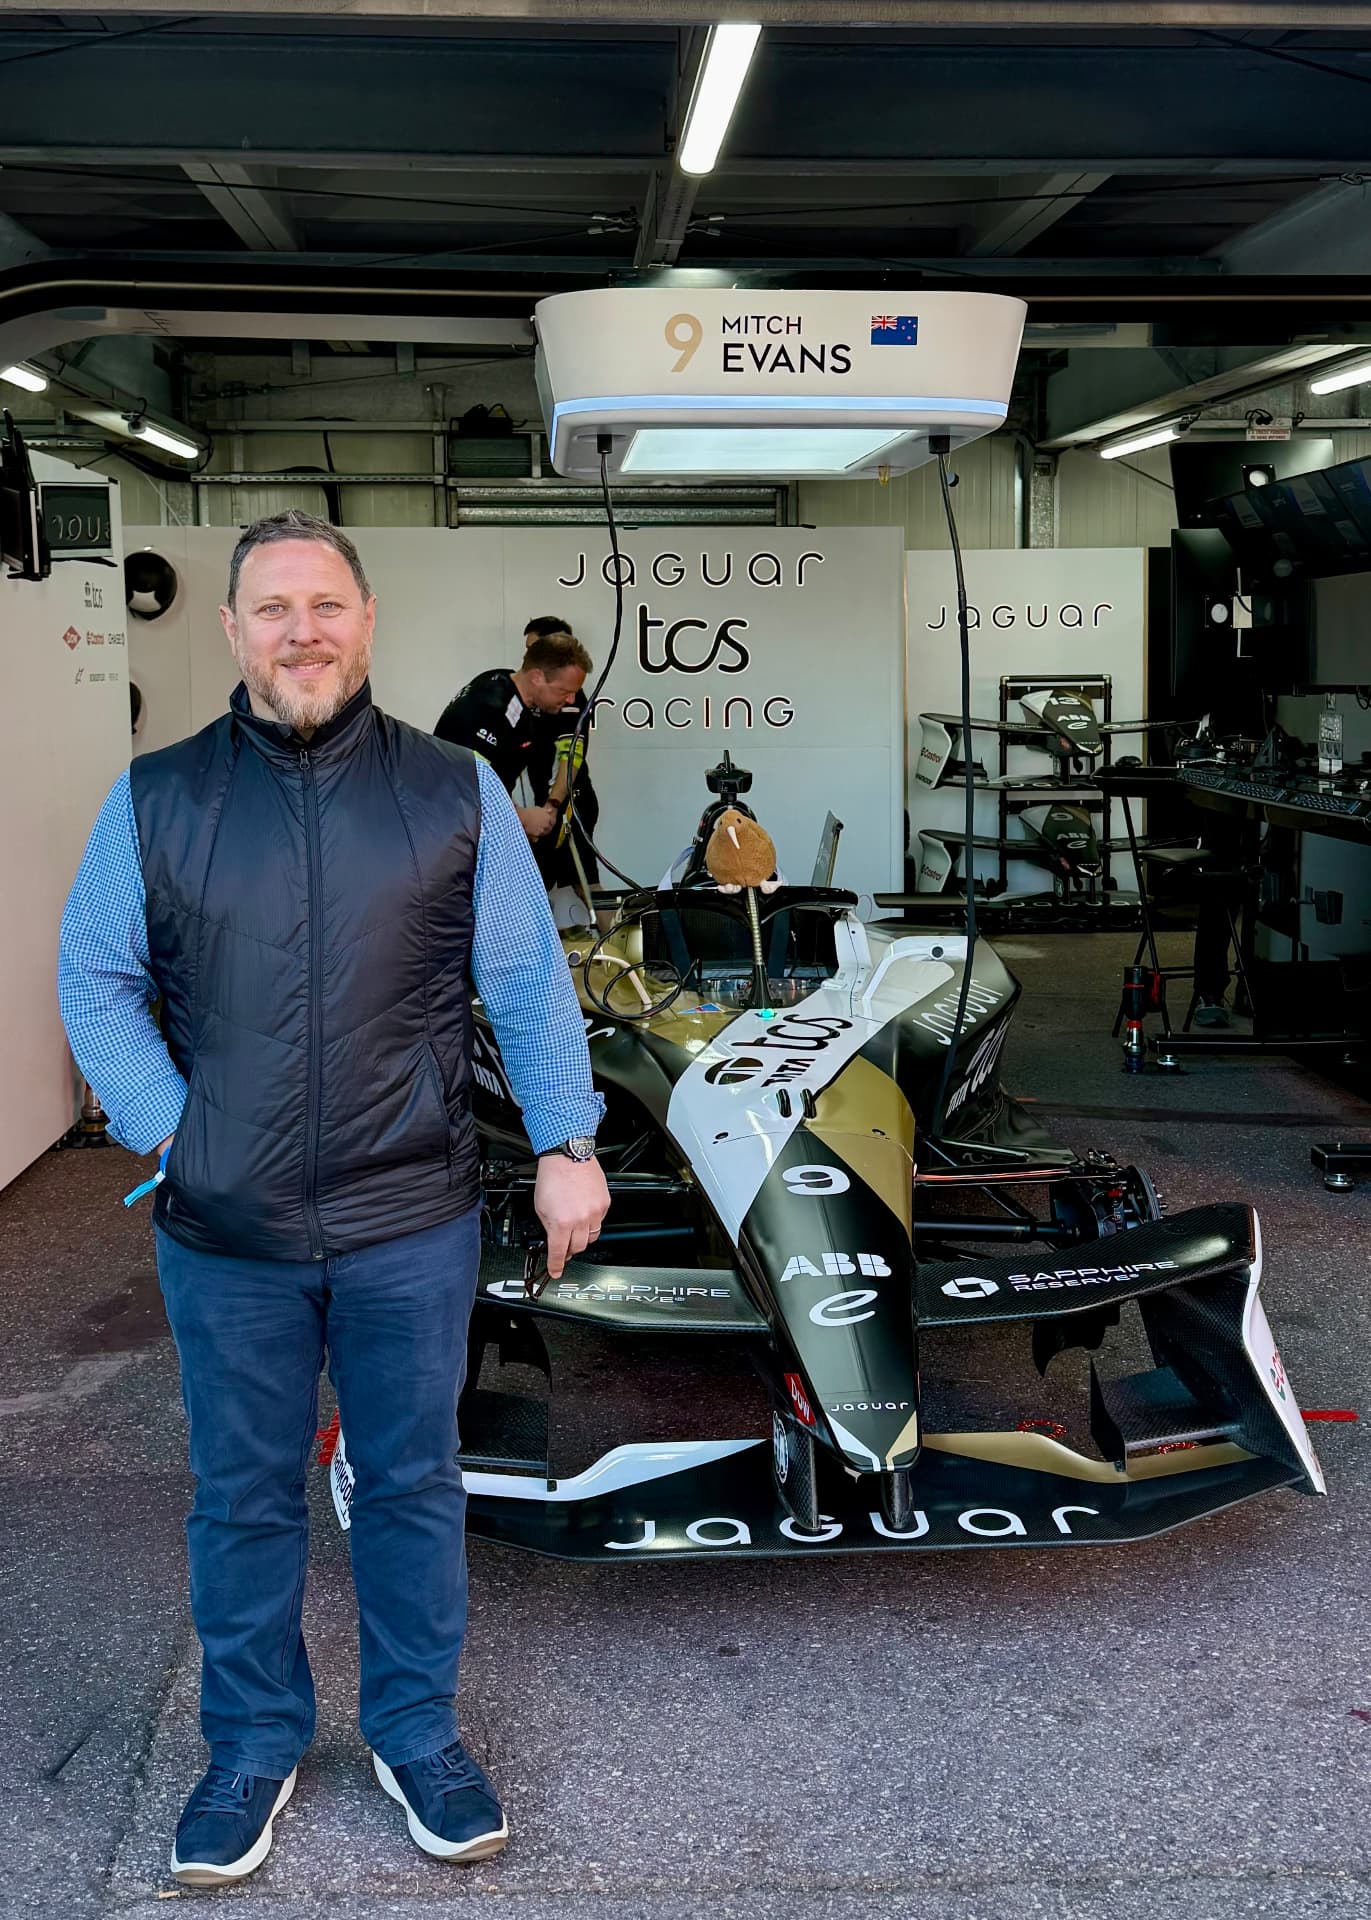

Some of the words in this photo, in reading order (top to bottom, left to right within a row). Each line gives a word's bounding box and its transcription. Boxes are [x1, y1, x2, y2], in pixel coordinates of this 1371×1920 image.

[721, 315, 802, 335] MITCH
[664, 313, 703, 373] 9
[721, 343, 852, 374] EVANS
[637, 603, 750, 674] tcs
[761, 1058, 816, 1088] TATA
[781, 1164, 850, 1196] 9
[780, 1252, 892, 1282] ABB
[1008, 1261, 1179, 1285] SAPPHIRE
[558, 1283, 731, 1298] SAPPHIRE
[790, 1376, 810, 1423] DOW
